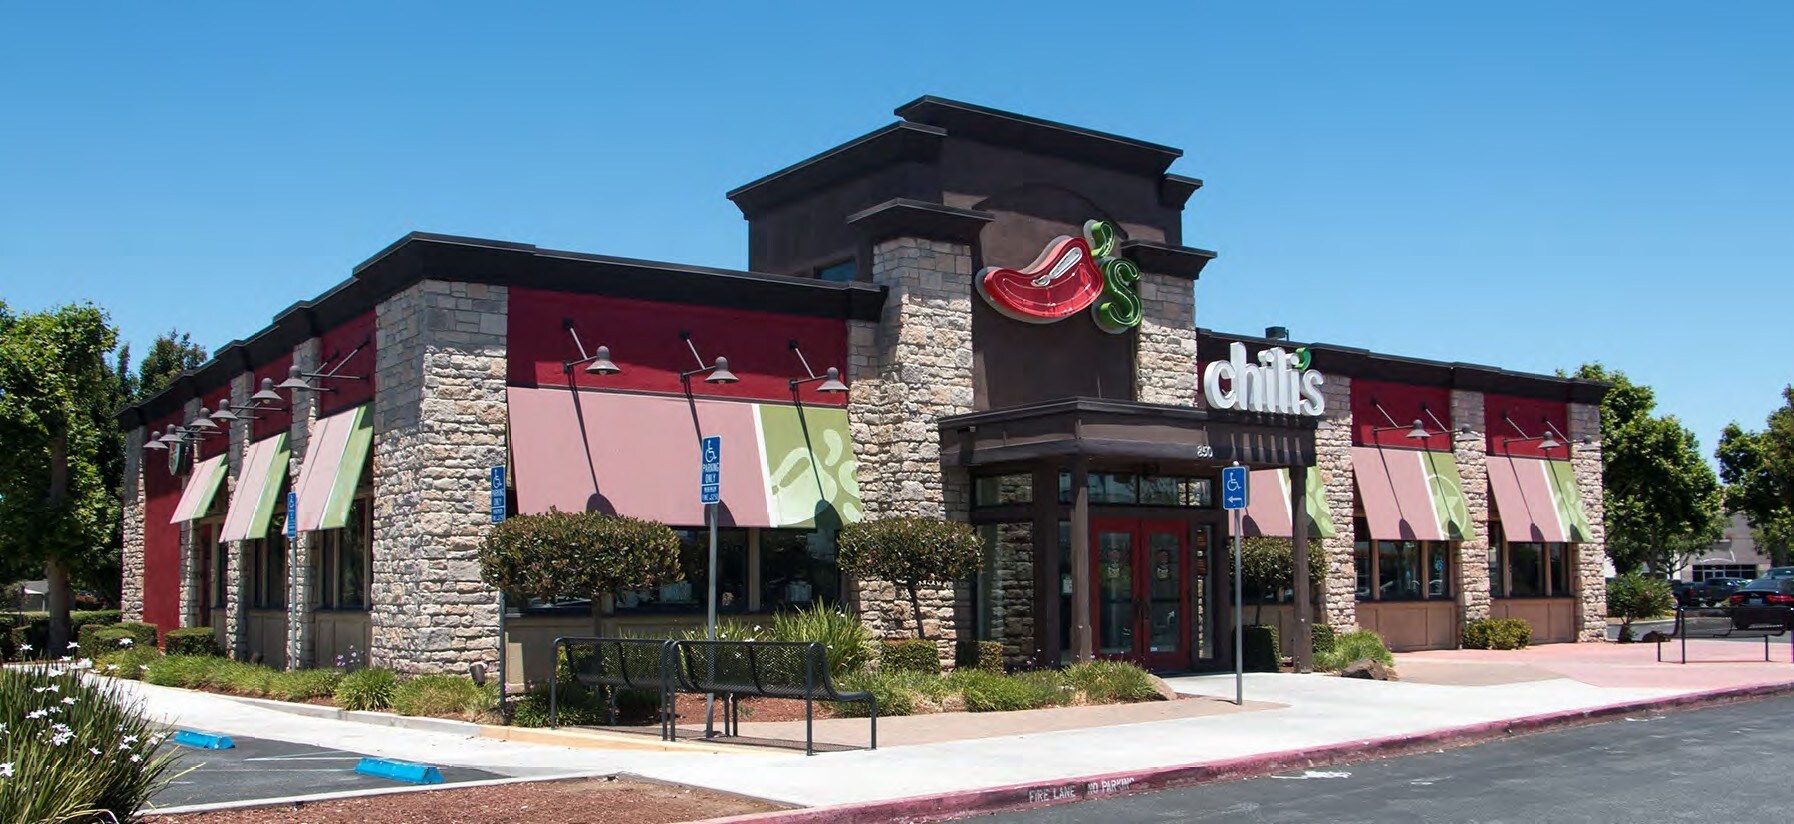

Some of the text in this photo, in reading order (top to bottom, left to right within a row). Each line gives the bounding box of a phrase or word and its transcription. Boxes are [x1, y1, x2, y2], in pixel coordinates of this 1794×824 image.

[1204, 342, 1325, 416] chili's
[1197, 445, 1213, 458] 850
[703, 463, 719, 472] PARKING
[705, 473, 716, 483] ONLY
[1029, 788, 1050, 803] FIRE
[1053, 785, 1076, 799] LANE
[1087, 782, 1099, 795] NO
